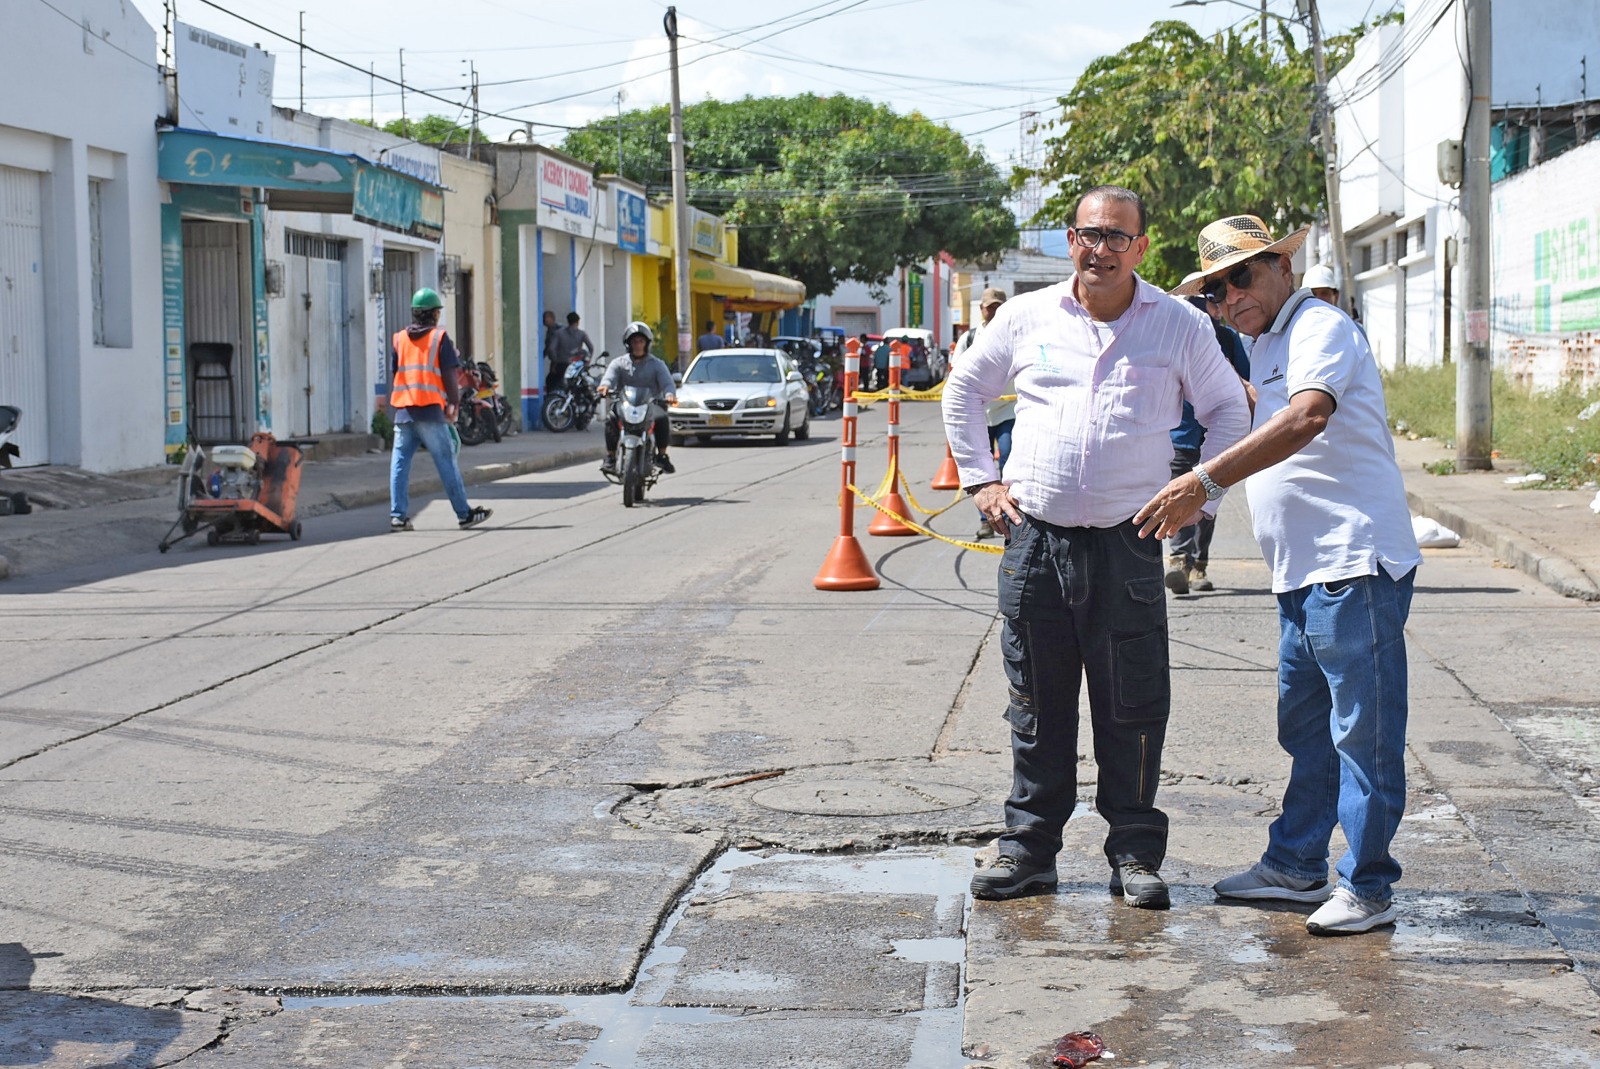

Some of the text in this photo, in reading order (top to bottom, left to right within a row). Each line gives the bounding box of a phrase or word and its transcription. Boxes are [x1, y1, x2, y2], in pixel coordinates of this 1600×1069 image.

[543, 160, 589, 197] ACEROS Y COCINAS
[565, 194, 589, 218] VALLEDUPAR
